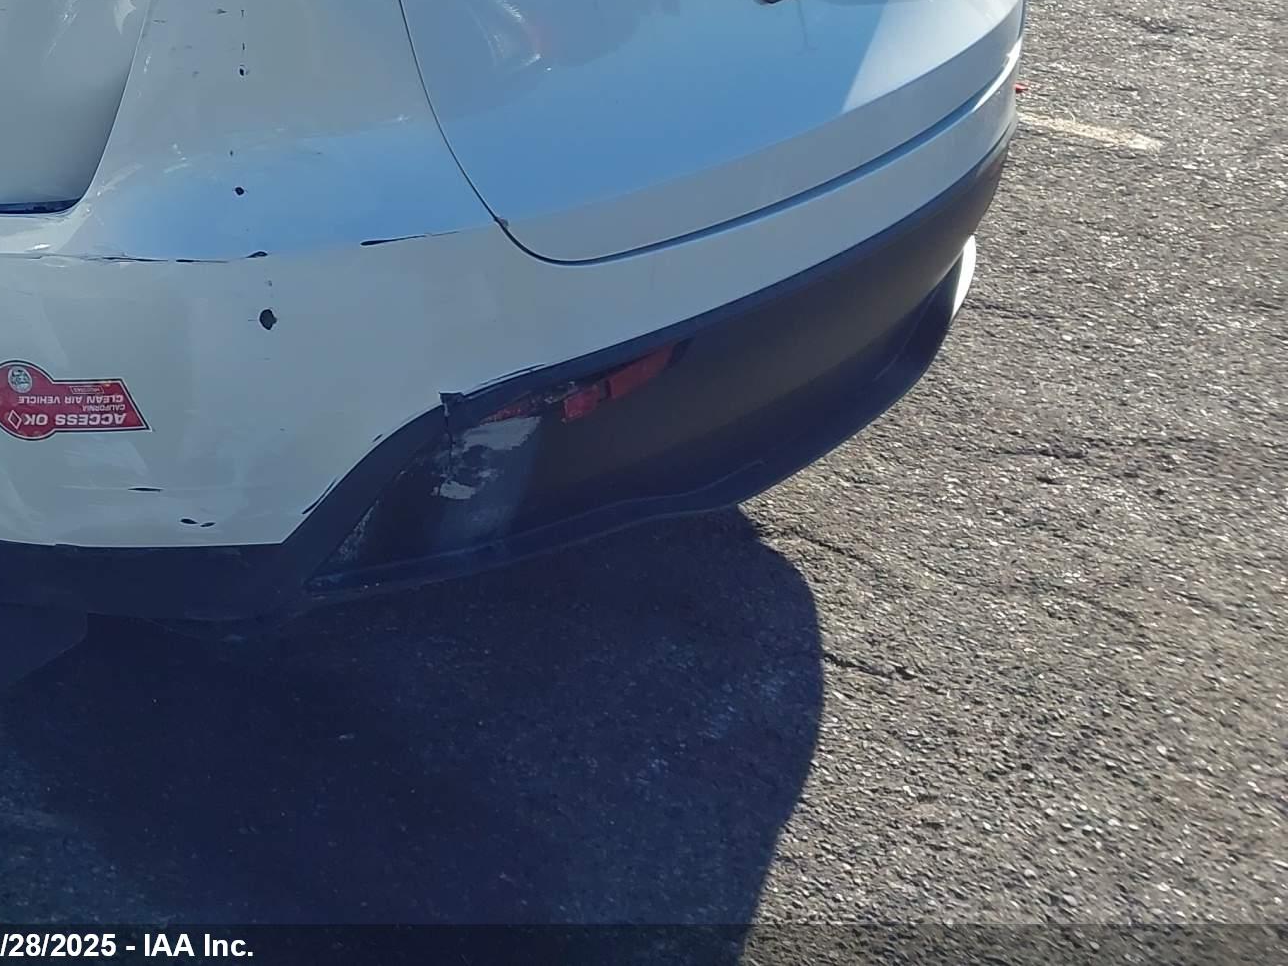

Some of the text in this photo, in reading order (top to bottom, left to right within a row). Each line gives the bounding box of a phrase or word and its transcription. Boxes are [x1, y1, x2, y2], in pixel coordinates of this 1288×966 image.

[18, 394, 123, 404] CLEAN AIR VEHICLE
[82, 404, 126, 412] CALIFORNIA
[24, 413, 127, 426] ACCESS OK
